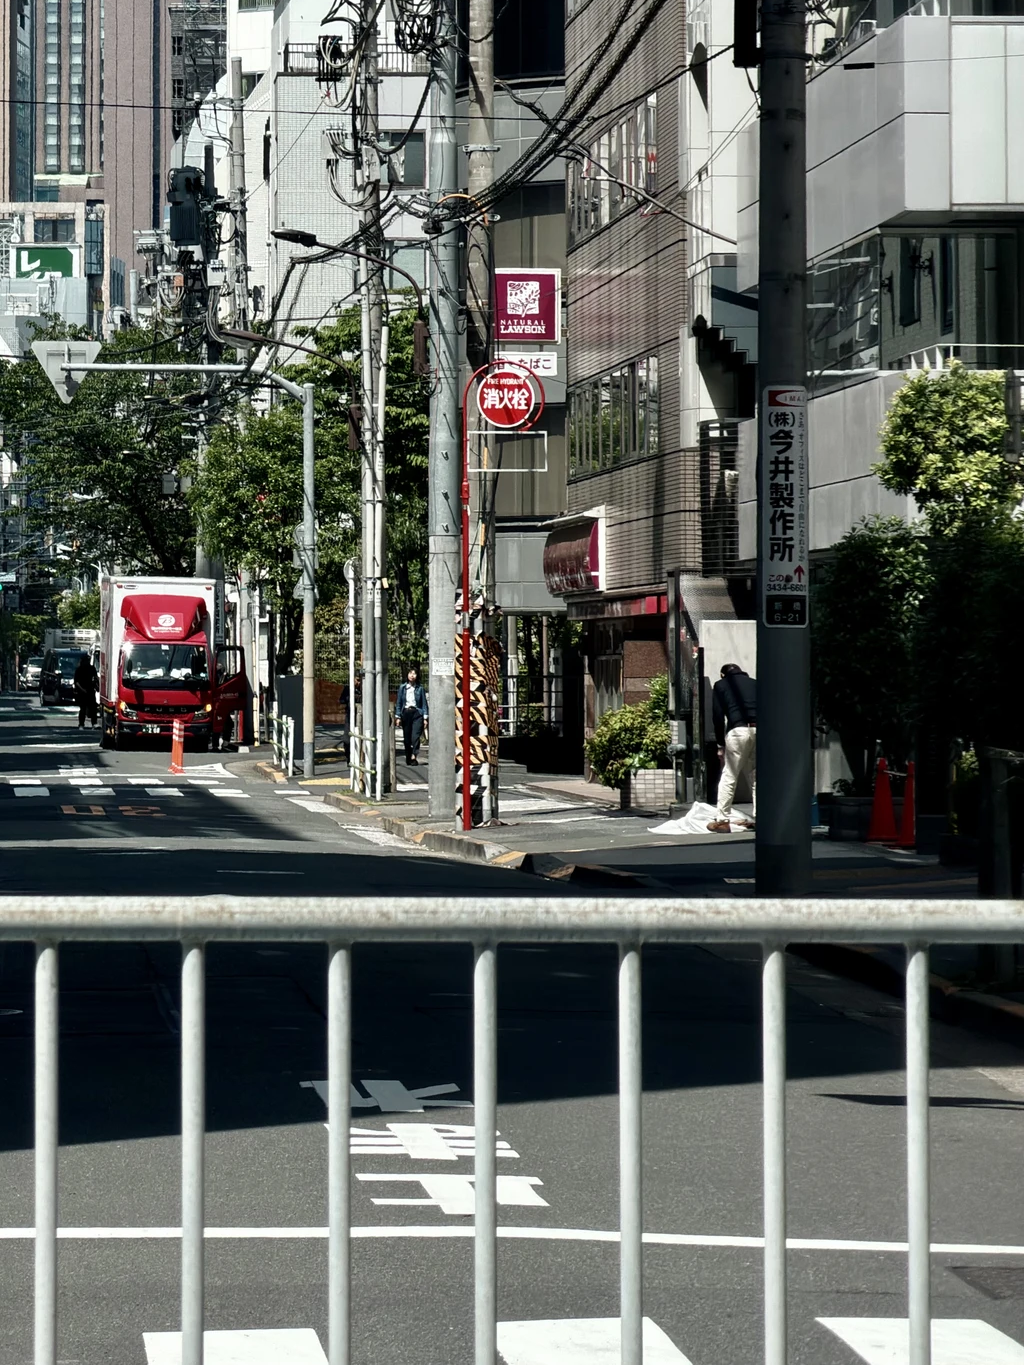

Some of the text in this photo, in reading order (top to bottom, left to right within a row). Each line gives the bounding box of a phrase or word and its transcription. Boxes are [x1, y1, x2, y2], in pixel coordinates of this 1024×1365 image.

[500, 325, 546, 334] LAWSON
[487, 377, 499, 385] FIRE
[482, 387, 530, 410] 消火栓
[773, 612, 800, 622] 6-21
